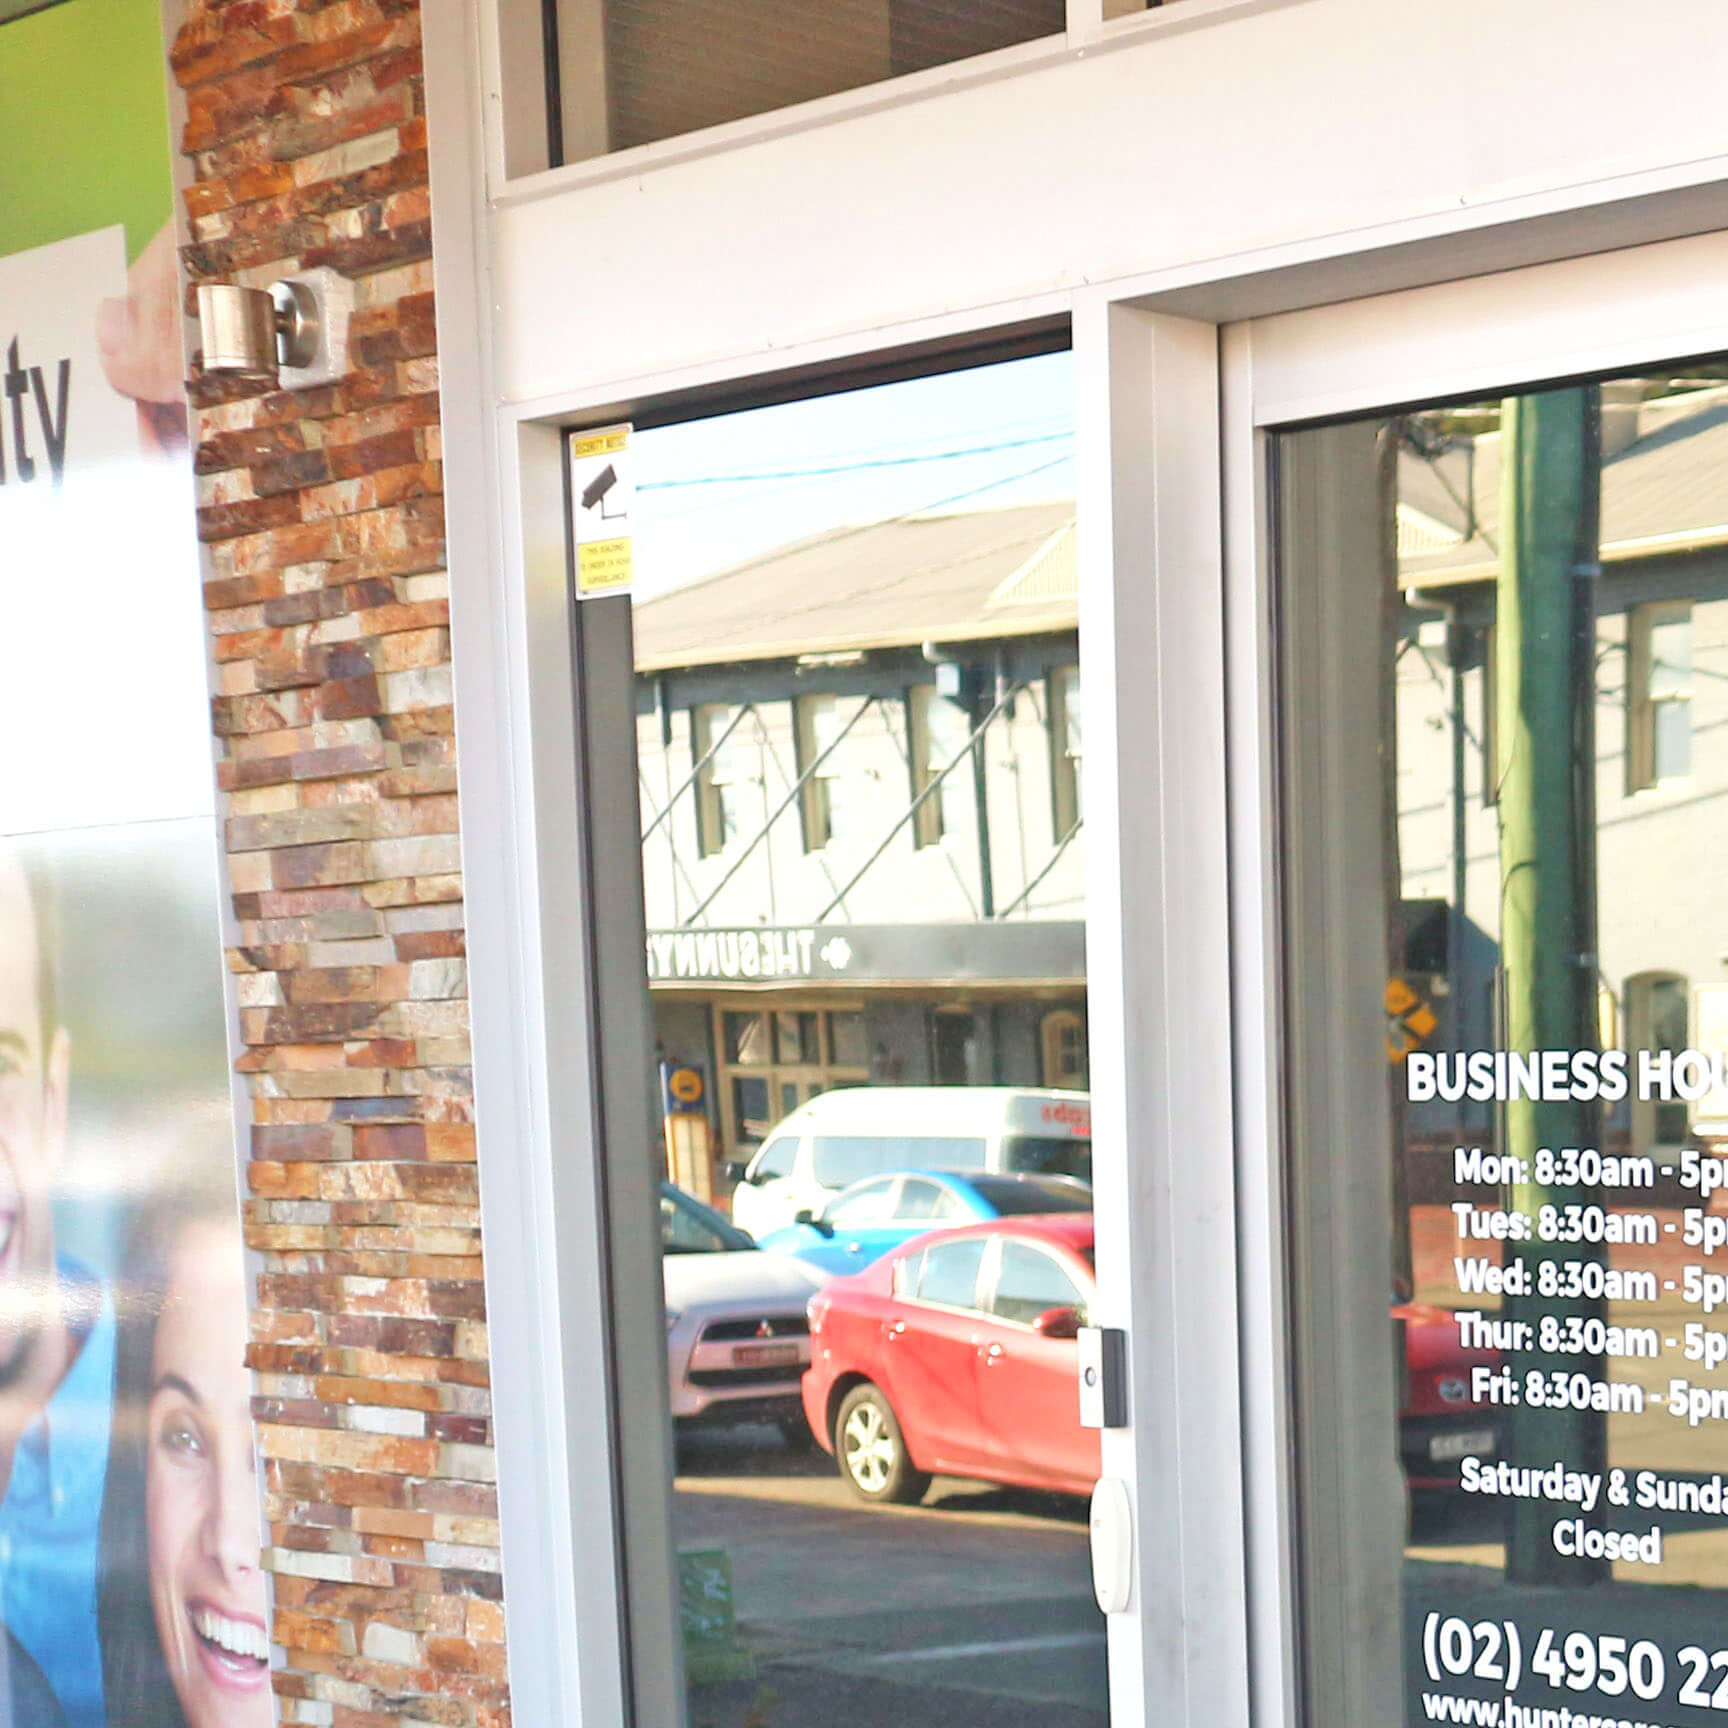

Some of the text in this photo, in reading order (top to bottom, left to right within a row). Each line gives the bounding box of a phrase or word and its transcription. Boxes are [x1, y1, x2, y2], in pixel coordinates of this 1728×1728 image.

[0, 332, 71, 497] ty
[1407, 1049, 1628, 1101] BUSINESS
[1453, 1148, 1528, 1186] Mon:
[1535, 1149, 1653, 1187] 8:30am
[1451, 1203, 1532, 1241] Tues:
[1538, 1205, 1657, 1244] 8:30am
[1453, 1258, 1532, 1296] Wed:
[1537, 1260, 1657, 1300] 8:30am
[1454, 1312, 1533, 1352] Thur:
[1539, 1316, 1658, 1358] 8:30am
[1471, 1366, 1520, 1406] Fri:
[1525, 1370, 1643, 1413] 8:30am
[1460, 1456, 1601, 1512] Saturday
[1607, 1469, 1631, 1506] &
[1552, 1519, 1662, 1564] Closed
[1422, 1612, 1522, 1691] (02)
[1532, 1629, 1666, 1701] 4950
